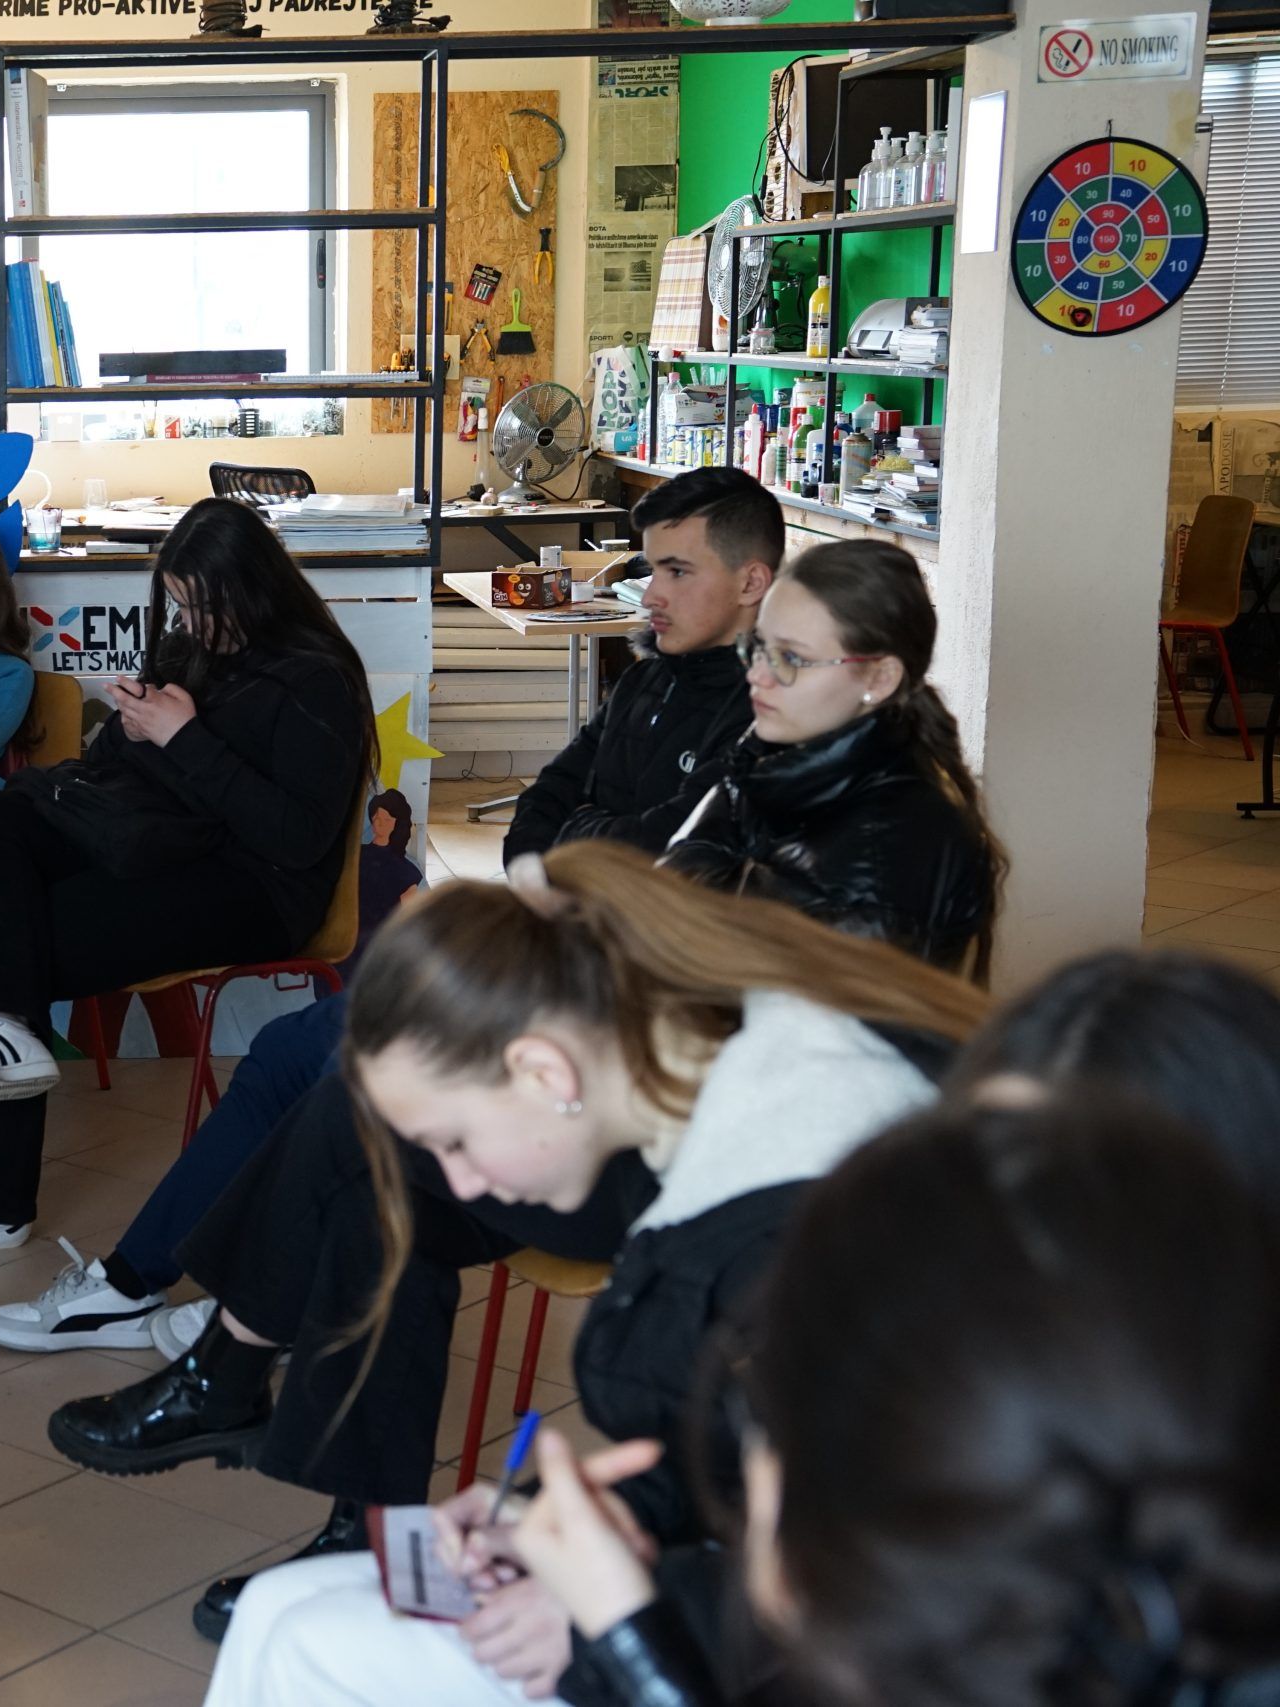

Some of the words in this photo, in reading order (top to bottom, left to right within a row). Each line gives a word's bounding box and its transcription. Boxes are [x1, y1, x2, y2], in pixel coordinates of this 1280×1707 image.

[58, 0, 196, 17] PRO-AKTIVE
[1099, 39, 1118, 66] NO
[1121, 35, 1179, 65] SMOKING
[1074, 162, 1092, 176] 10
[1129, 159, 1146, 172] 10
[1086, 190, 1098, 199] 30
[1120, 189, 1132, 198] 40
[1102, 209, 1115, 218] 90
[1173, 204, 1192, 217] 10
[1030, 209, 1047, 222] 10
[1147, 215, 1160, 224] 50
[1058, 218, 1070, 227] 20
[1076, 235, 1089, 244] 80
[1098, 235, 1115, 244] 100
[1125, 234, 1138, 243] 70
[1054, 255, 1066, 264] 30
[1145, 252, 1158, 261] 20
[1098, 260, 1111, 268] 60
[1169, 260, 1188, 273] 10
[1025, 264, 1042, 277] 10
[1076, 281, 1089, 290] 40
[1112, 280, 1126, 289] 50
[1117, 304, 1135, 317] 10
[52, 651, 103, 672] LET'S
